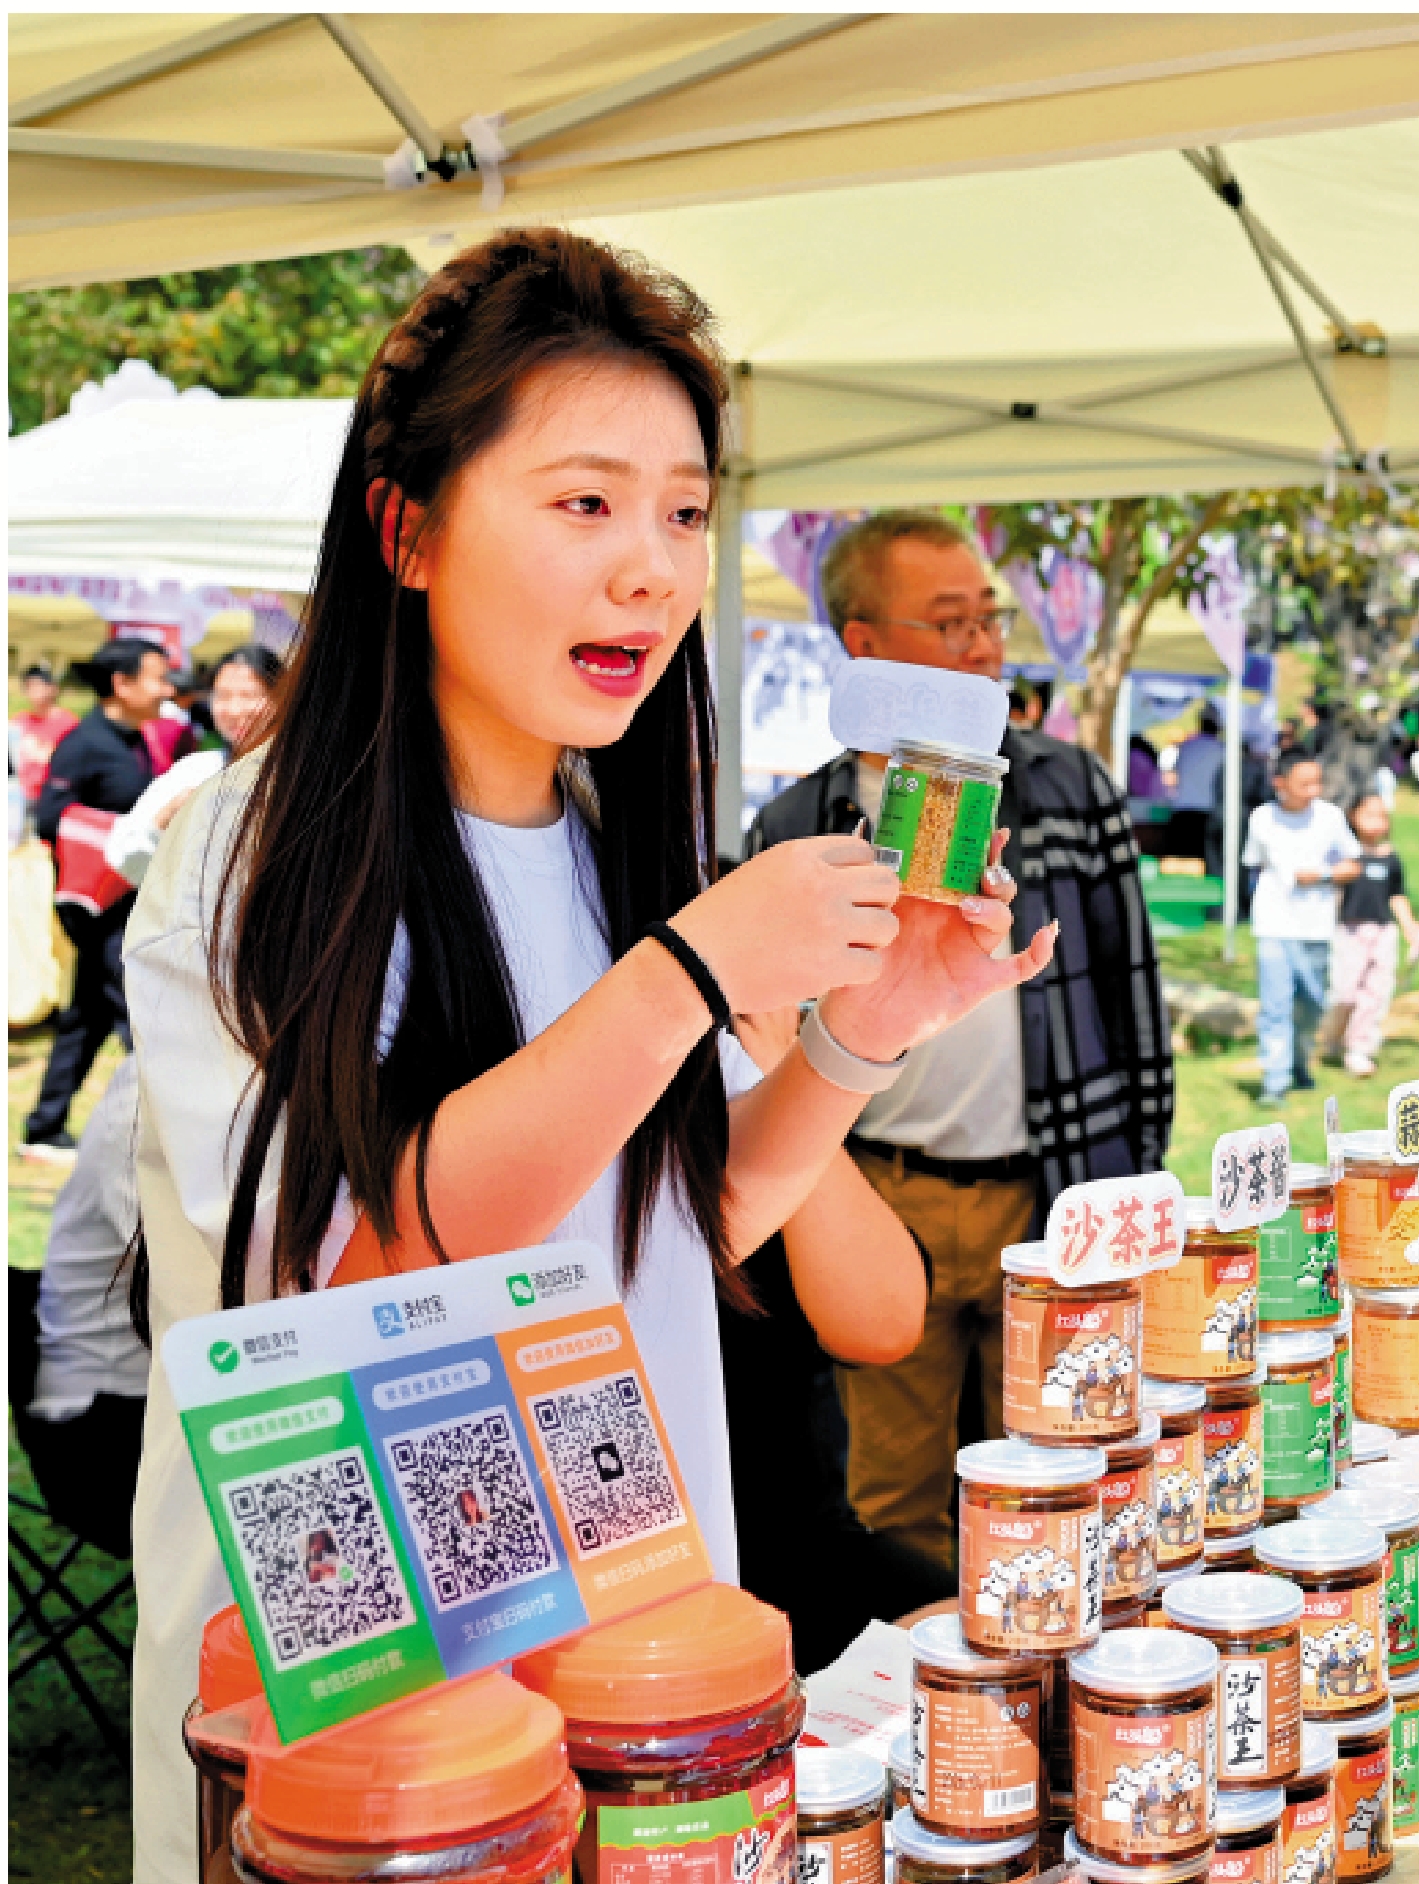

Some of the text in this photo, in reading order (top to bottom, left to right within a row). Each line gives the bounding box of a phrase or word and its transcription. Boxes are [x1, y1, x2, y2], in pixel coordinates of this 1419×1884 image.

[1061, 1196, 1178, 1268] 沙茶王
[402, 1294, 446, 1321] 支付宝
[1227, 1670, 1265, 1766] 沙茶王
